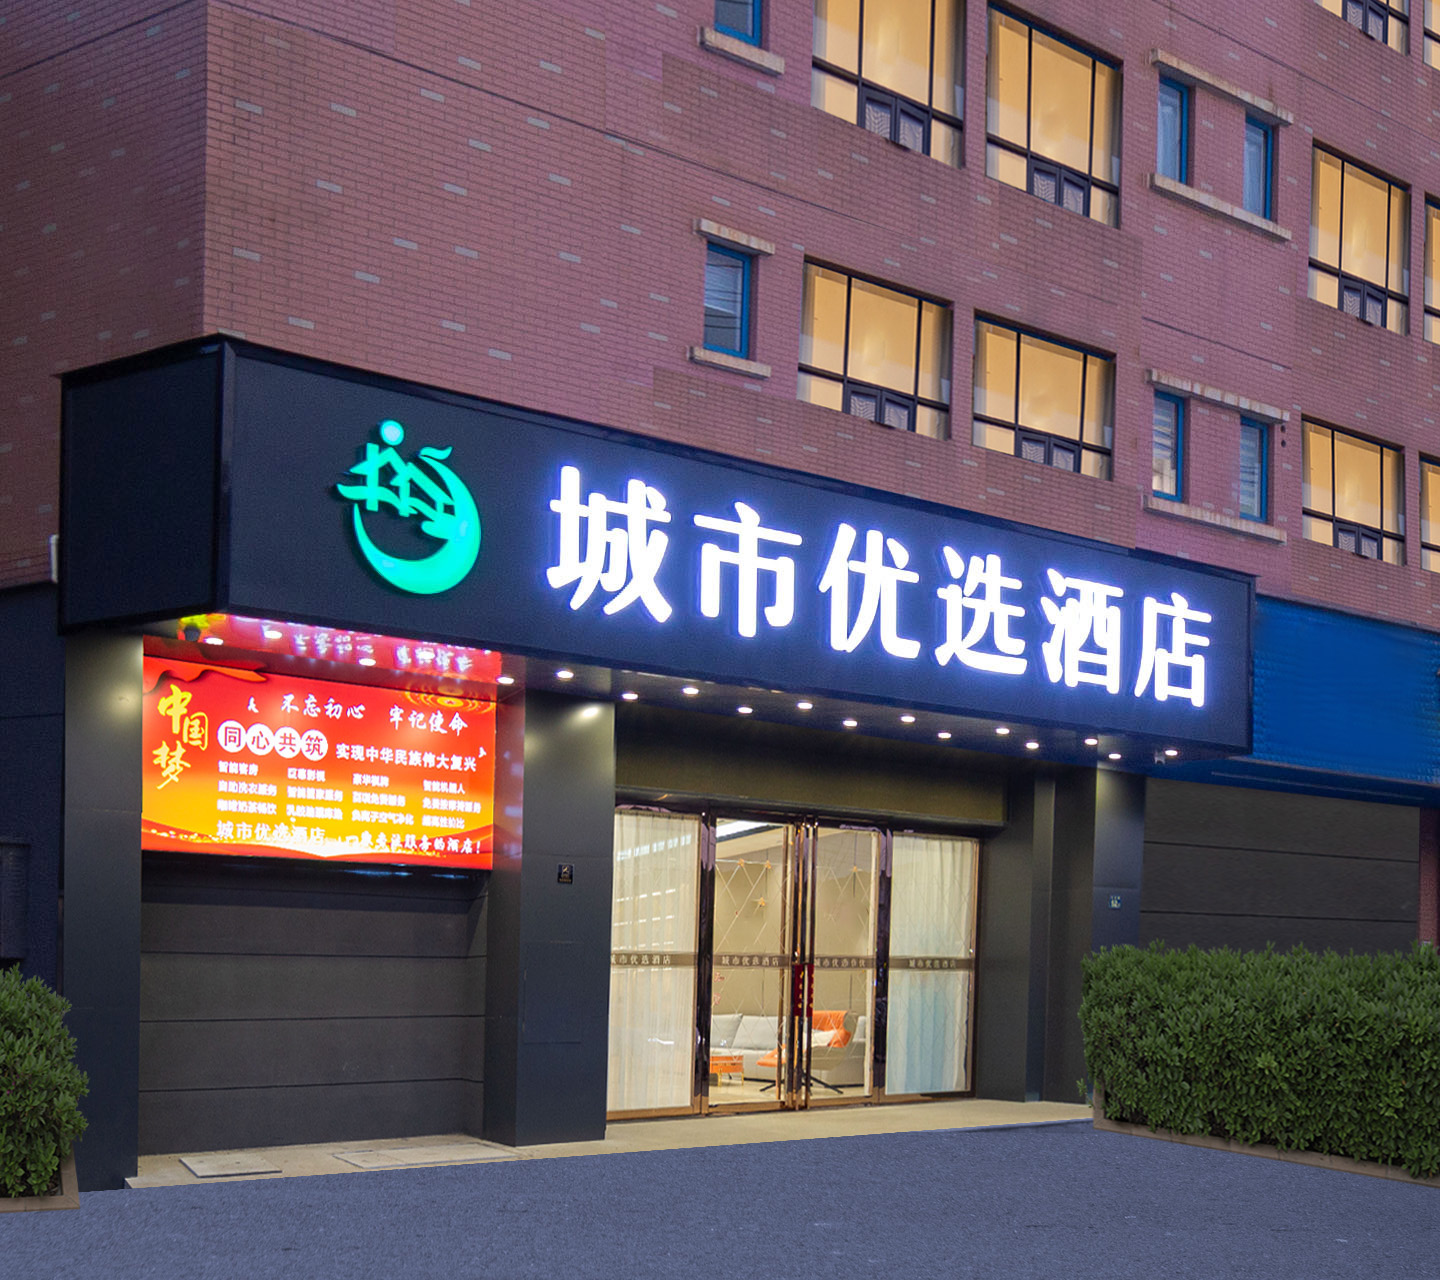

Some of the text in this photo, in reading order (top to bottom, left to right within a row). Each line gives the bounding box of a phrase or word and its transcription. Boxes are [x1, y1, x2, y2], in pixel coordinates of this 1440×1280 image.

[545, 464, 1214, 708] 城市优选酒店
[280, 693, 366, 721] 不忘初心
[388, 705, 469, 737] 牢记使命
[152, 683, 210, 790] 中国梦
[222, 724, 326, 759] 同心共筑
[335, 743, 478, 772] 实现中华民族伟大复兴
[218, 780, 278, 796] 自助洗衣服务
[423, 779, 466, 794] 智能机器人
[216, 820, 326, 847] 城市优选酒店
